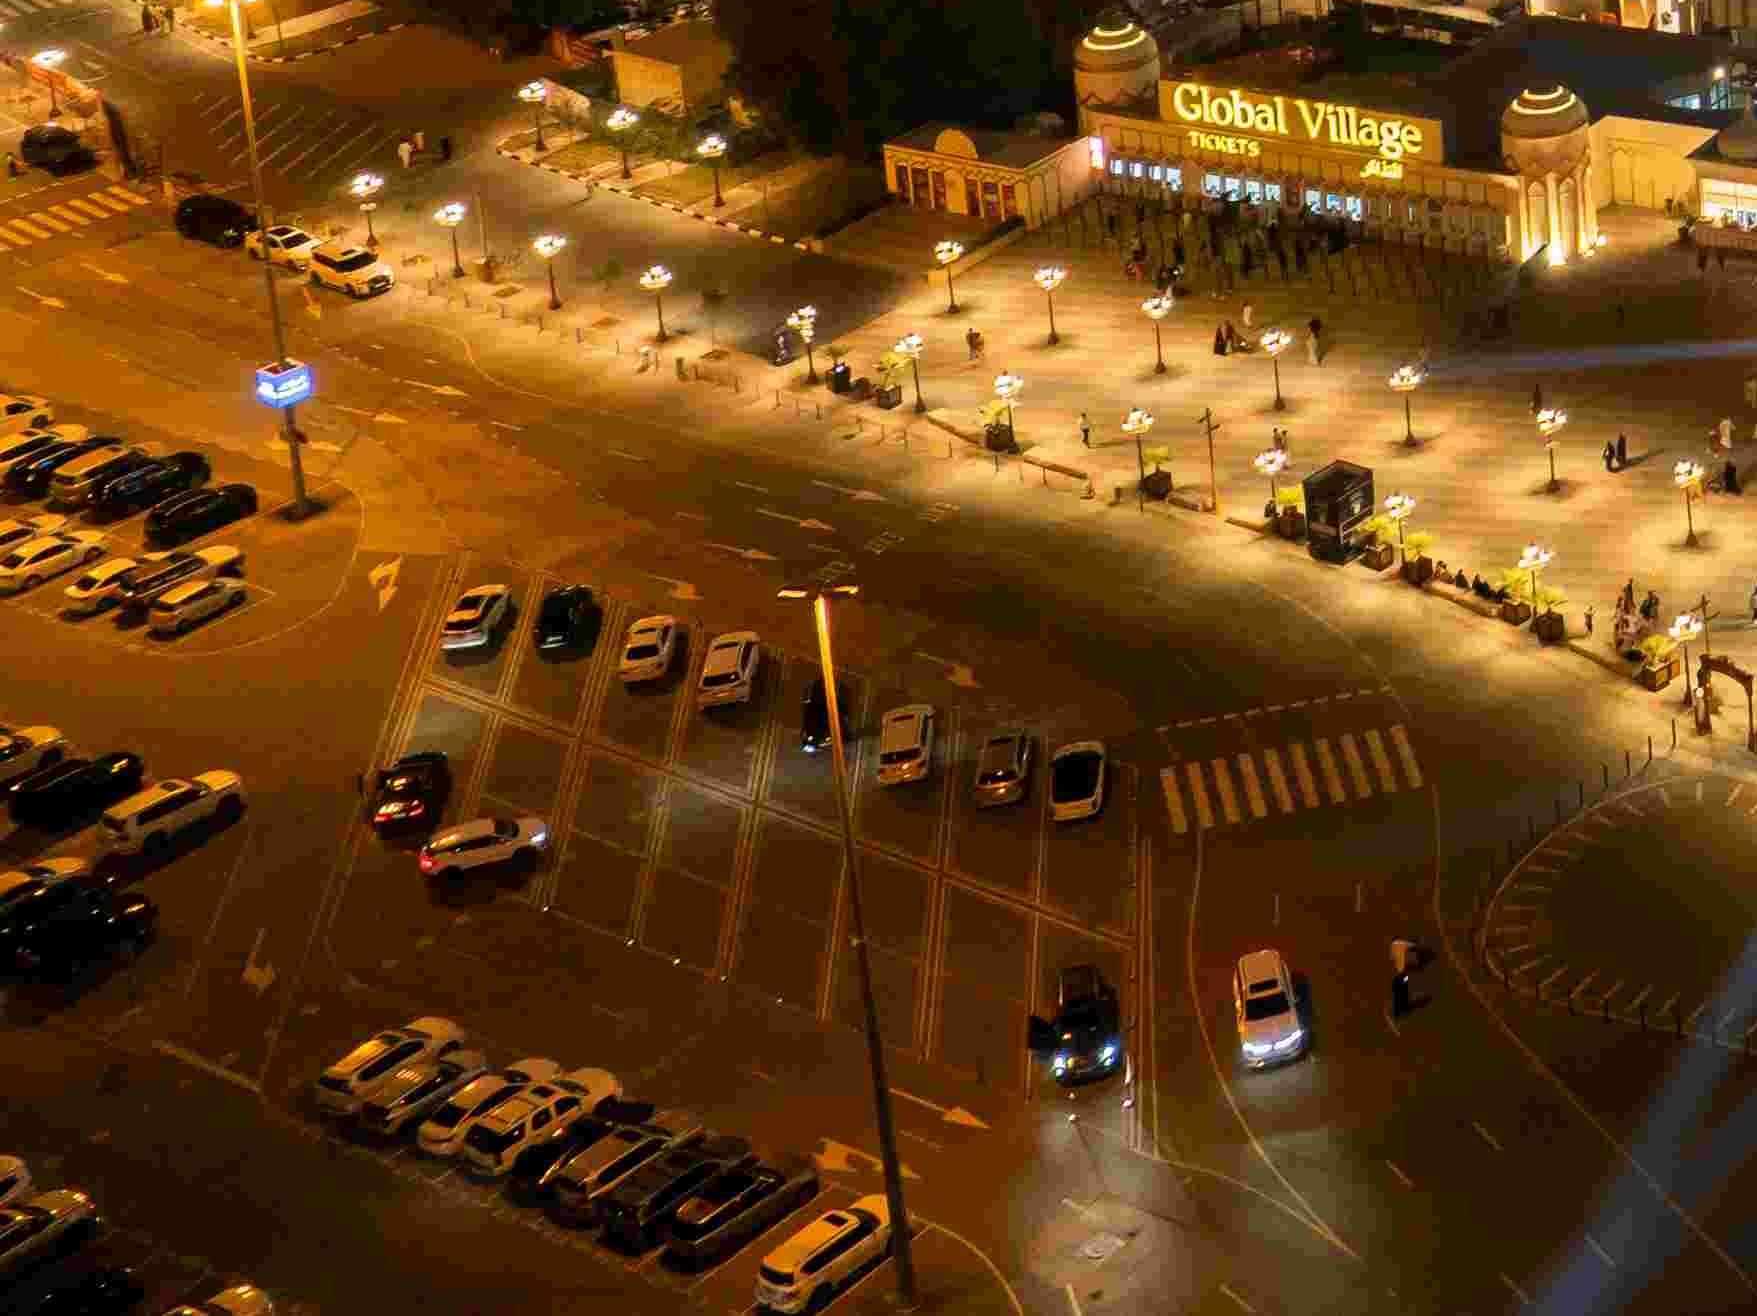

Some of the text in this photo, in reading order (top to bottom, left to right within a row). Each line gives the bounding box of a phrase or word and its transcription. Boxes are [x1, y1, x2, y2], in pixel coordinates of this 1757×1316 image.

[1174, 82, 1424, 160] Global Village
[1187, 130, 1261, 158] TICKETS
